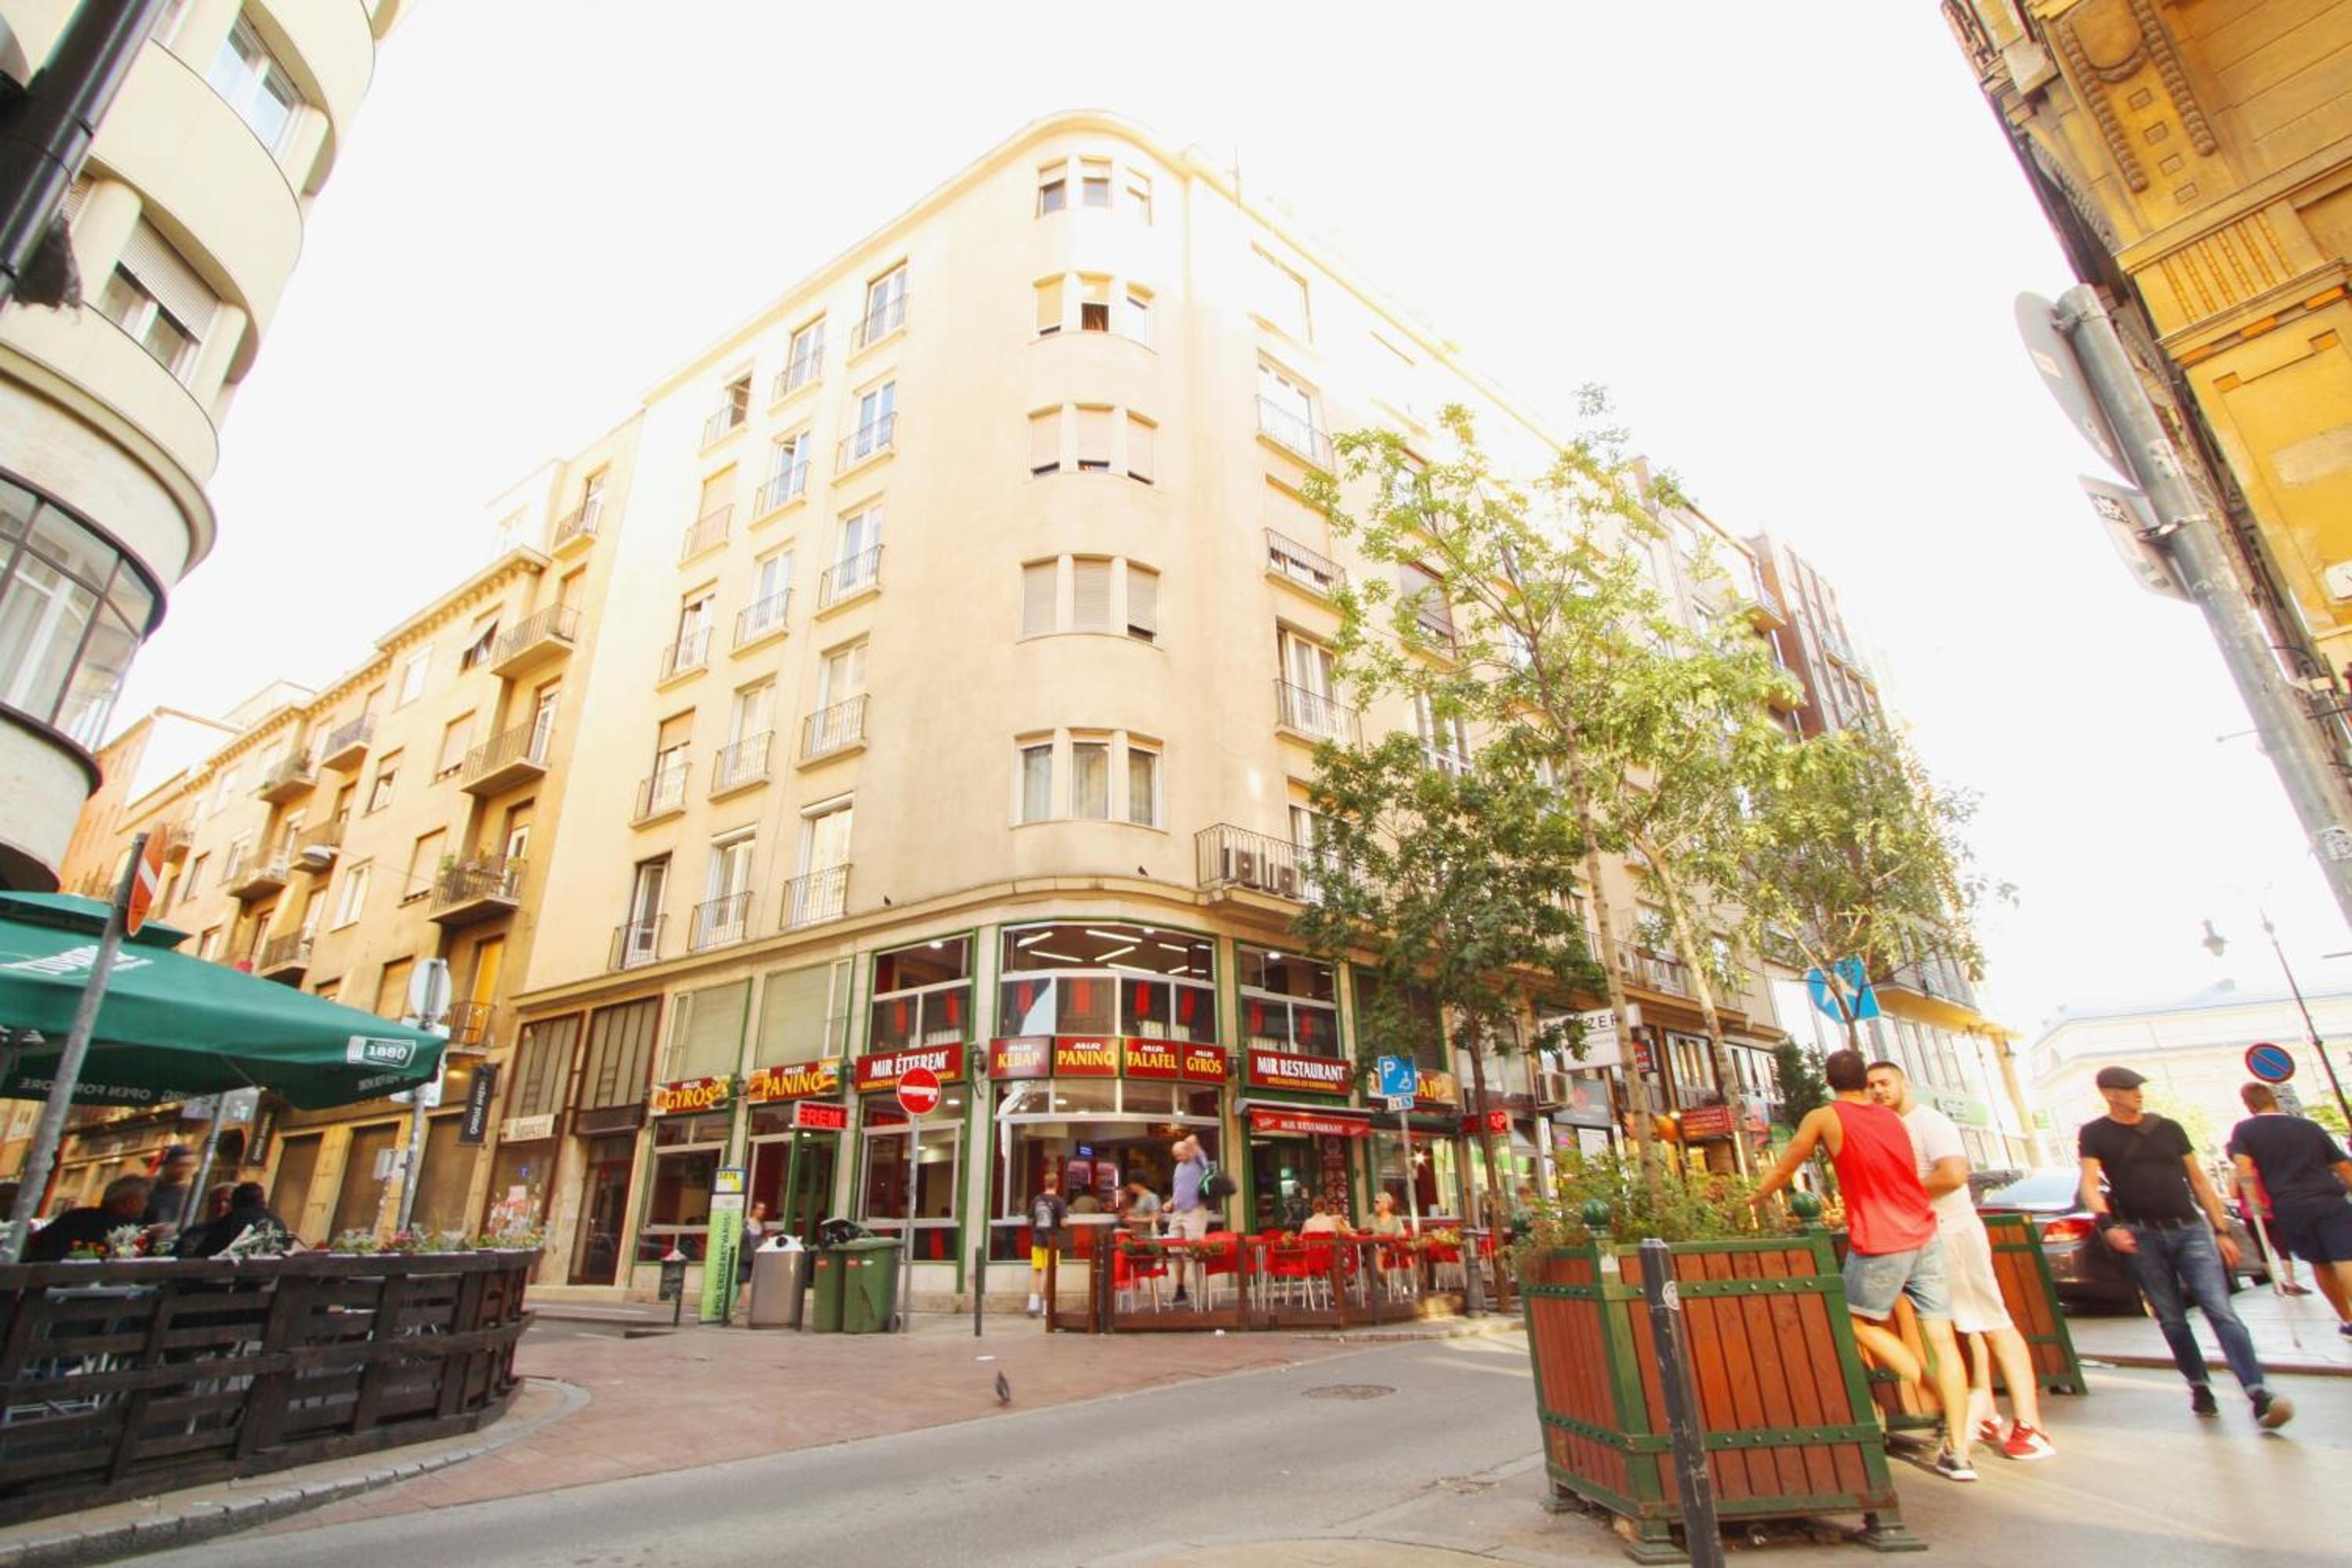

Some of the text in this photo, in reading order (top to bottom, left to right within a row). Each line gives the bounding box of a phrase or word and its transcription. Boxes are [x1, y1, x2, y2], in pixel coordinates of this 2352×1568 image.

[870, 1058, 893, 1079] MIR
[1058, 1051, 1116, 1067] PANINO
[1127, 1051, 1178, 1069] FALAFEL
[1186, 1056, 1223, 1075] GYROS
[1257, 1056, 1345, 1082] MIR RESTAURANT
[1383, 1061, 1396, 1080] P
[762, 1072, 824, 1097] PANINO
[665, 1086, 714, 1111] GYROS
